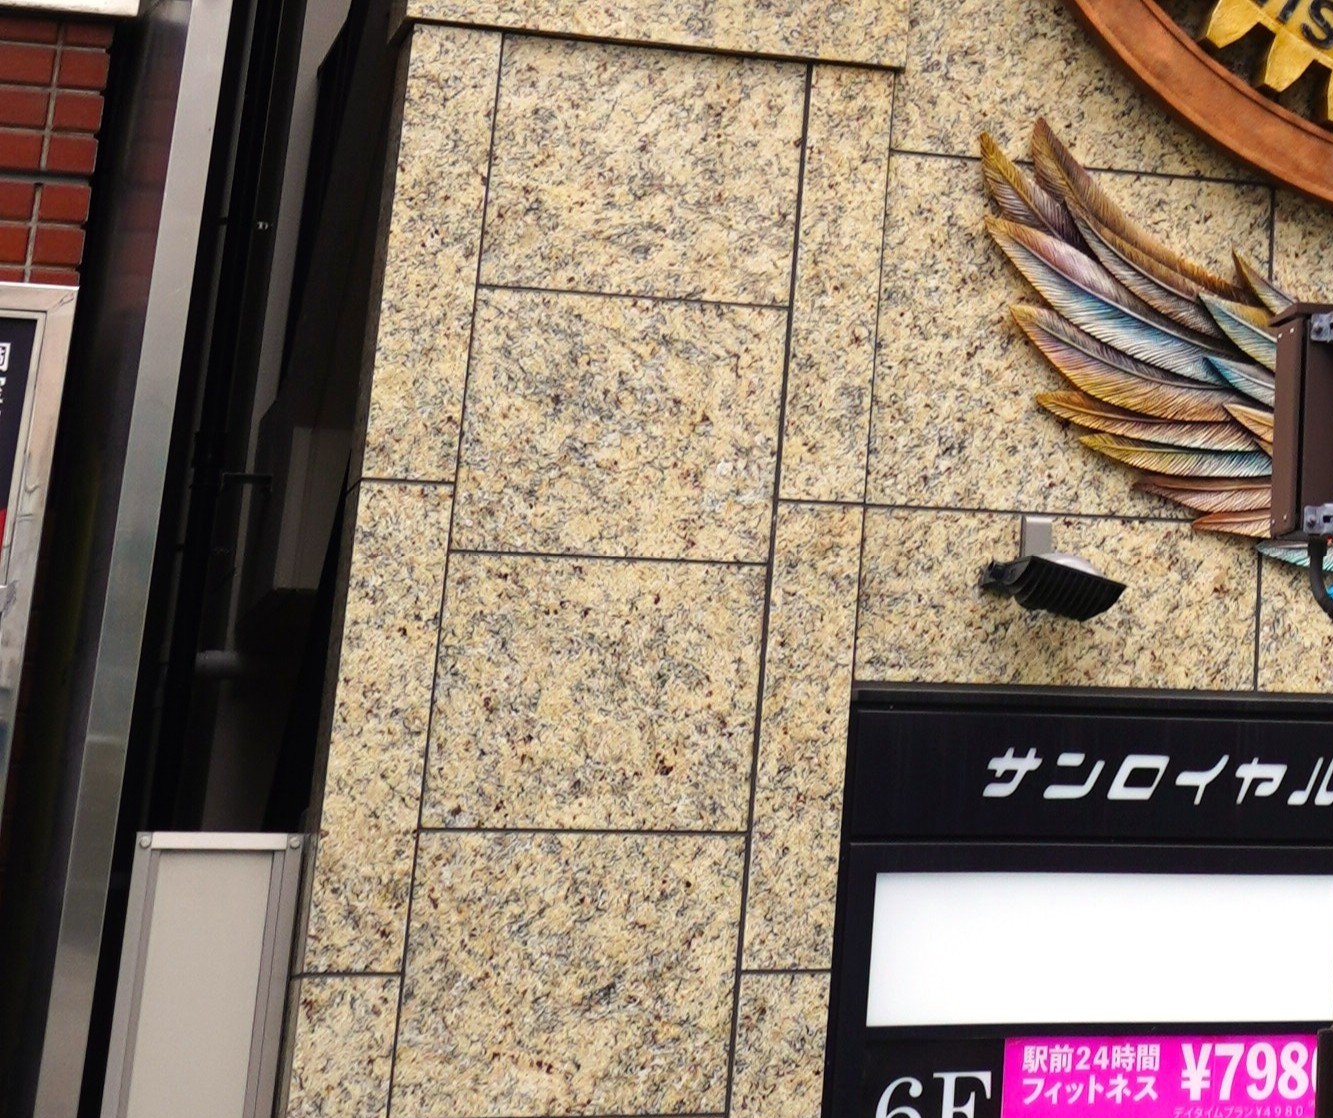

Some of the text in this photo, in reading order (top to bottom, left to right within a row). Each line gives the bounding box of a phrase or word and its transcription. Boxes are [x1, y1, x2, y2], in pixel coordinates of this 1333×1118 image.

[1021, 1043, 1161, 1074] 駅前24時間
[1180, 1041, 1317, 1102] ¥798
[1021, 1073, 1160, 1105] フィットネス
